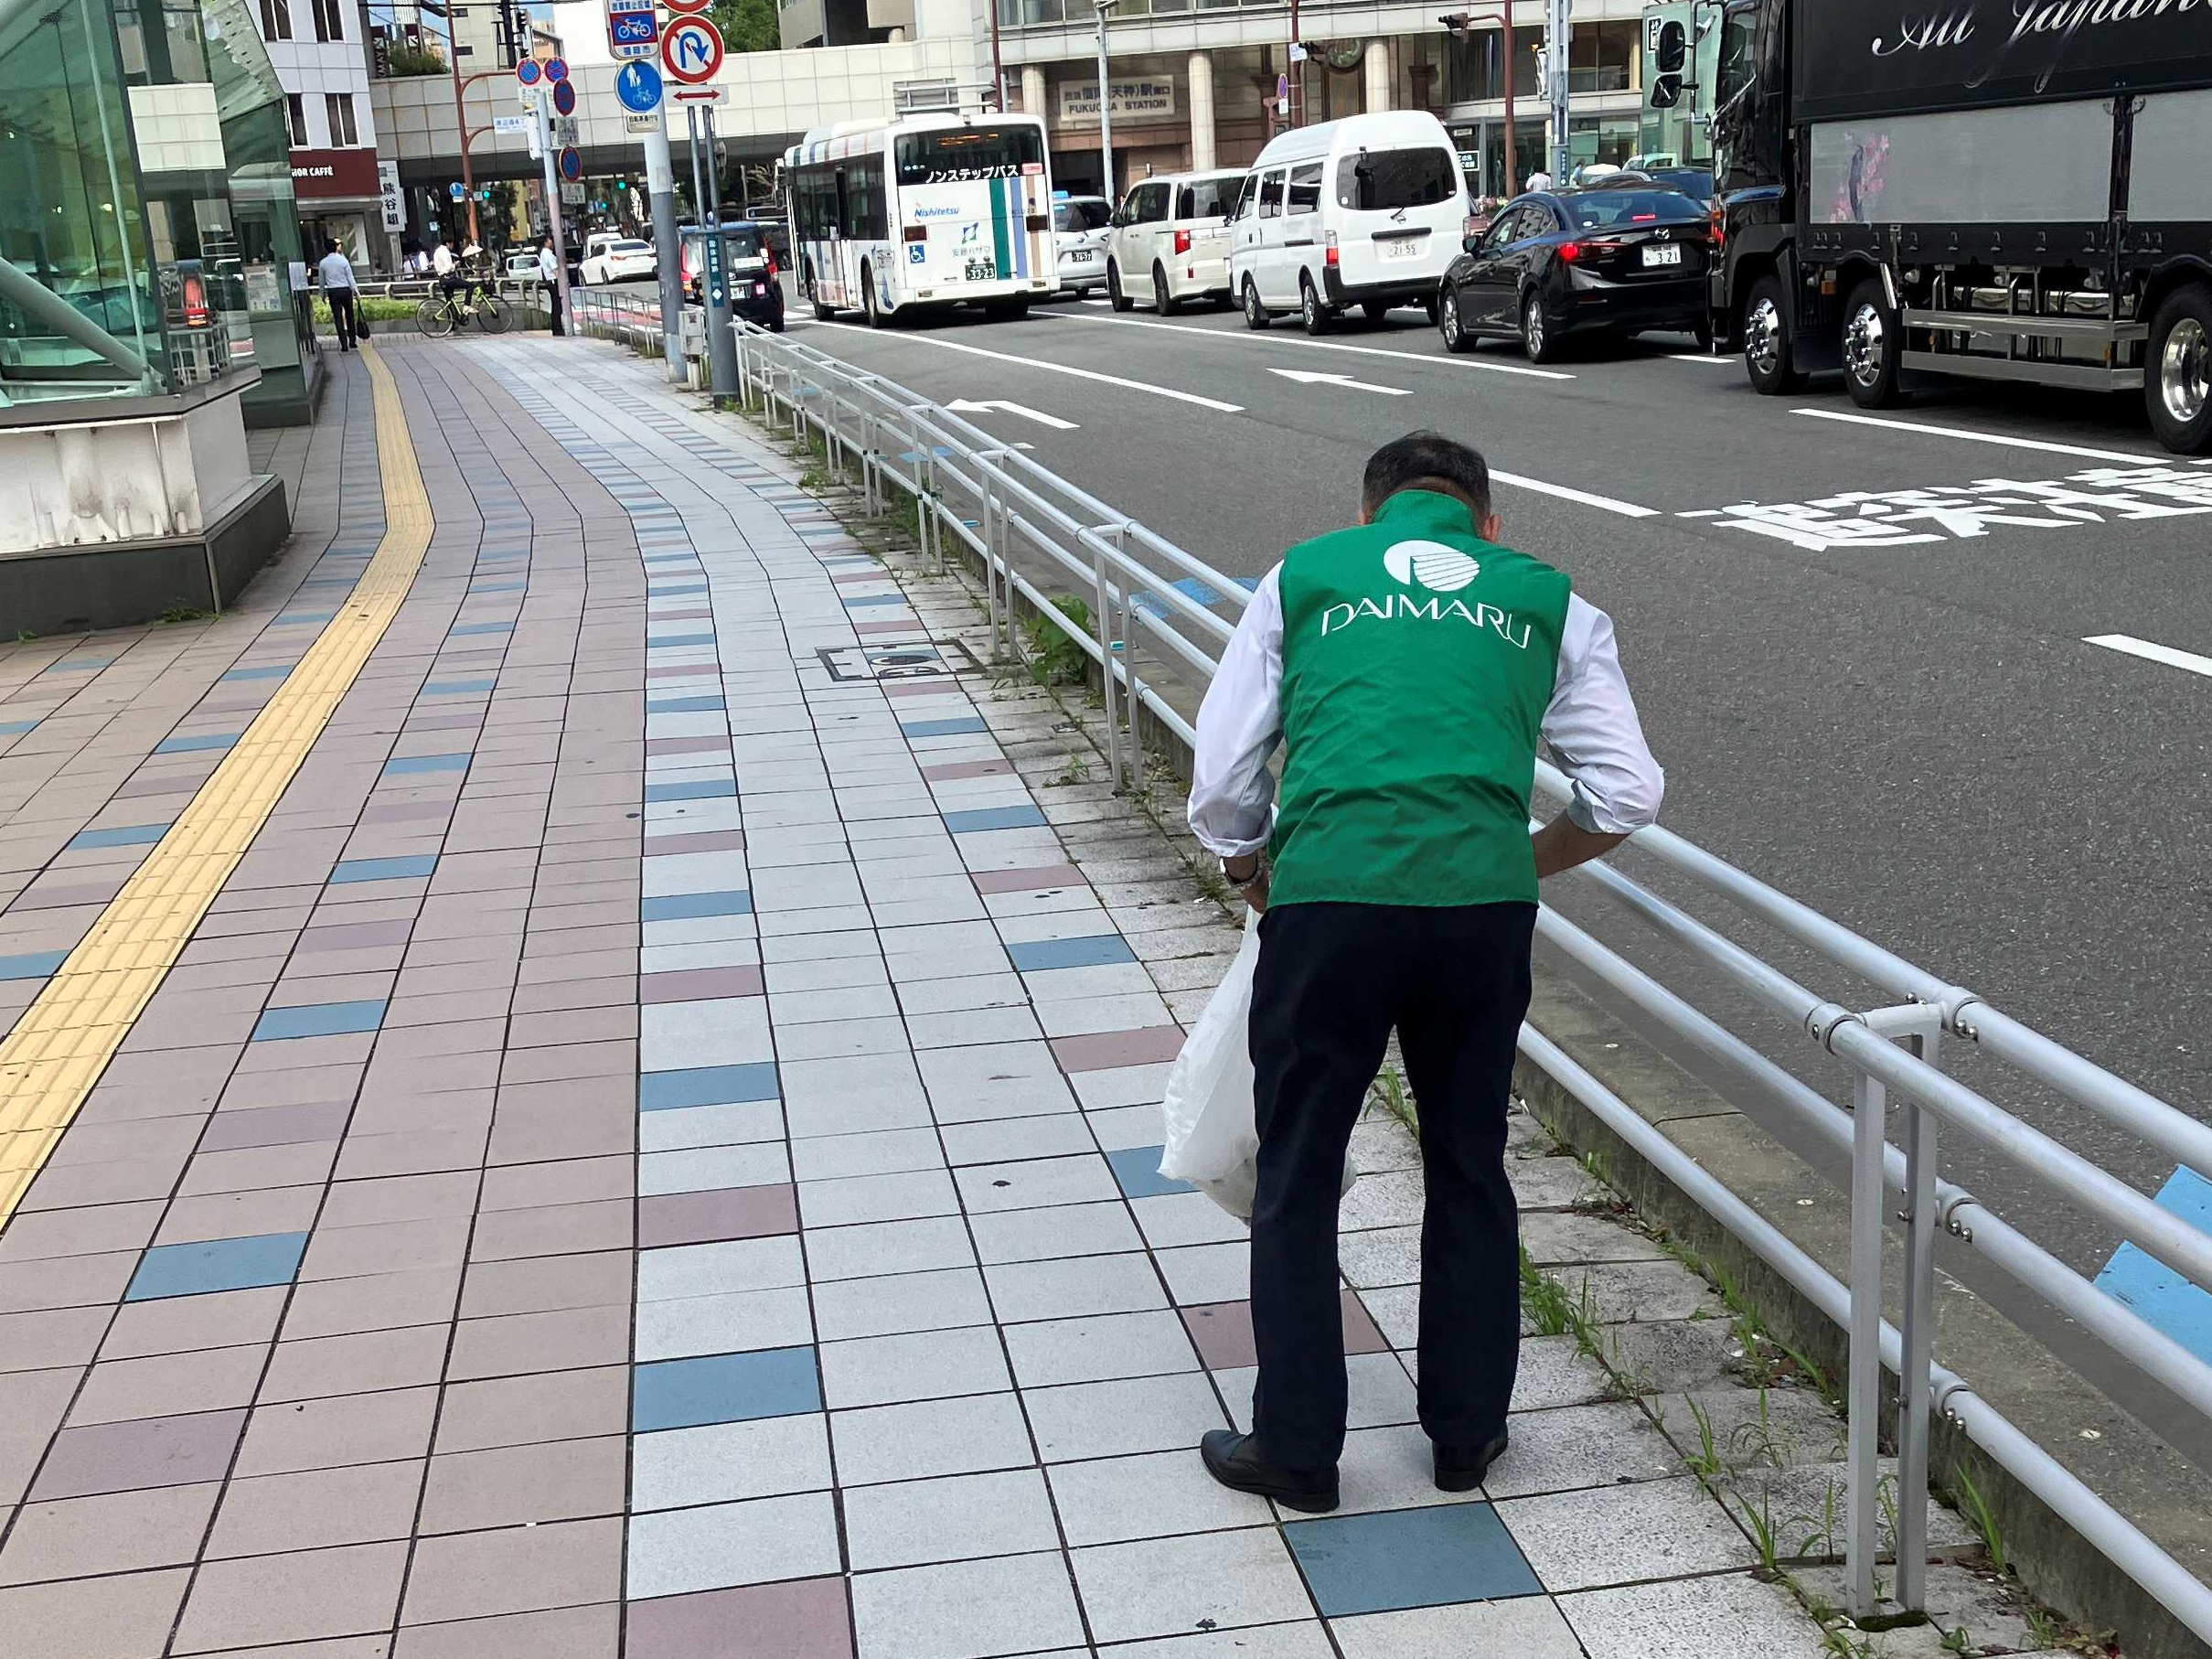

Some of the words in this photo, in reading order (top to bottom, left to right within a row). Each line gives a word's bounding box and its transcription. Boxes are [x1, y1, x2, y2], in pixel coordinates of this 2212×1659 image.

[1872, 2, 1975, 57] All
[1069, 102, 1117, 114] FUKUA
[1126, 99, 1167, 110] STATION
[925, 165, 1019, 184] ノンステップバス
[382, 182, 399, 225] 熊谷組
[914, 207, 960, 217] Nishitetsu
[709, 240, 719, 273] 国体道路
[1673, 466, 2212, 552] 追突注意
[1320, 594, 1531, 648] DAIMARU
